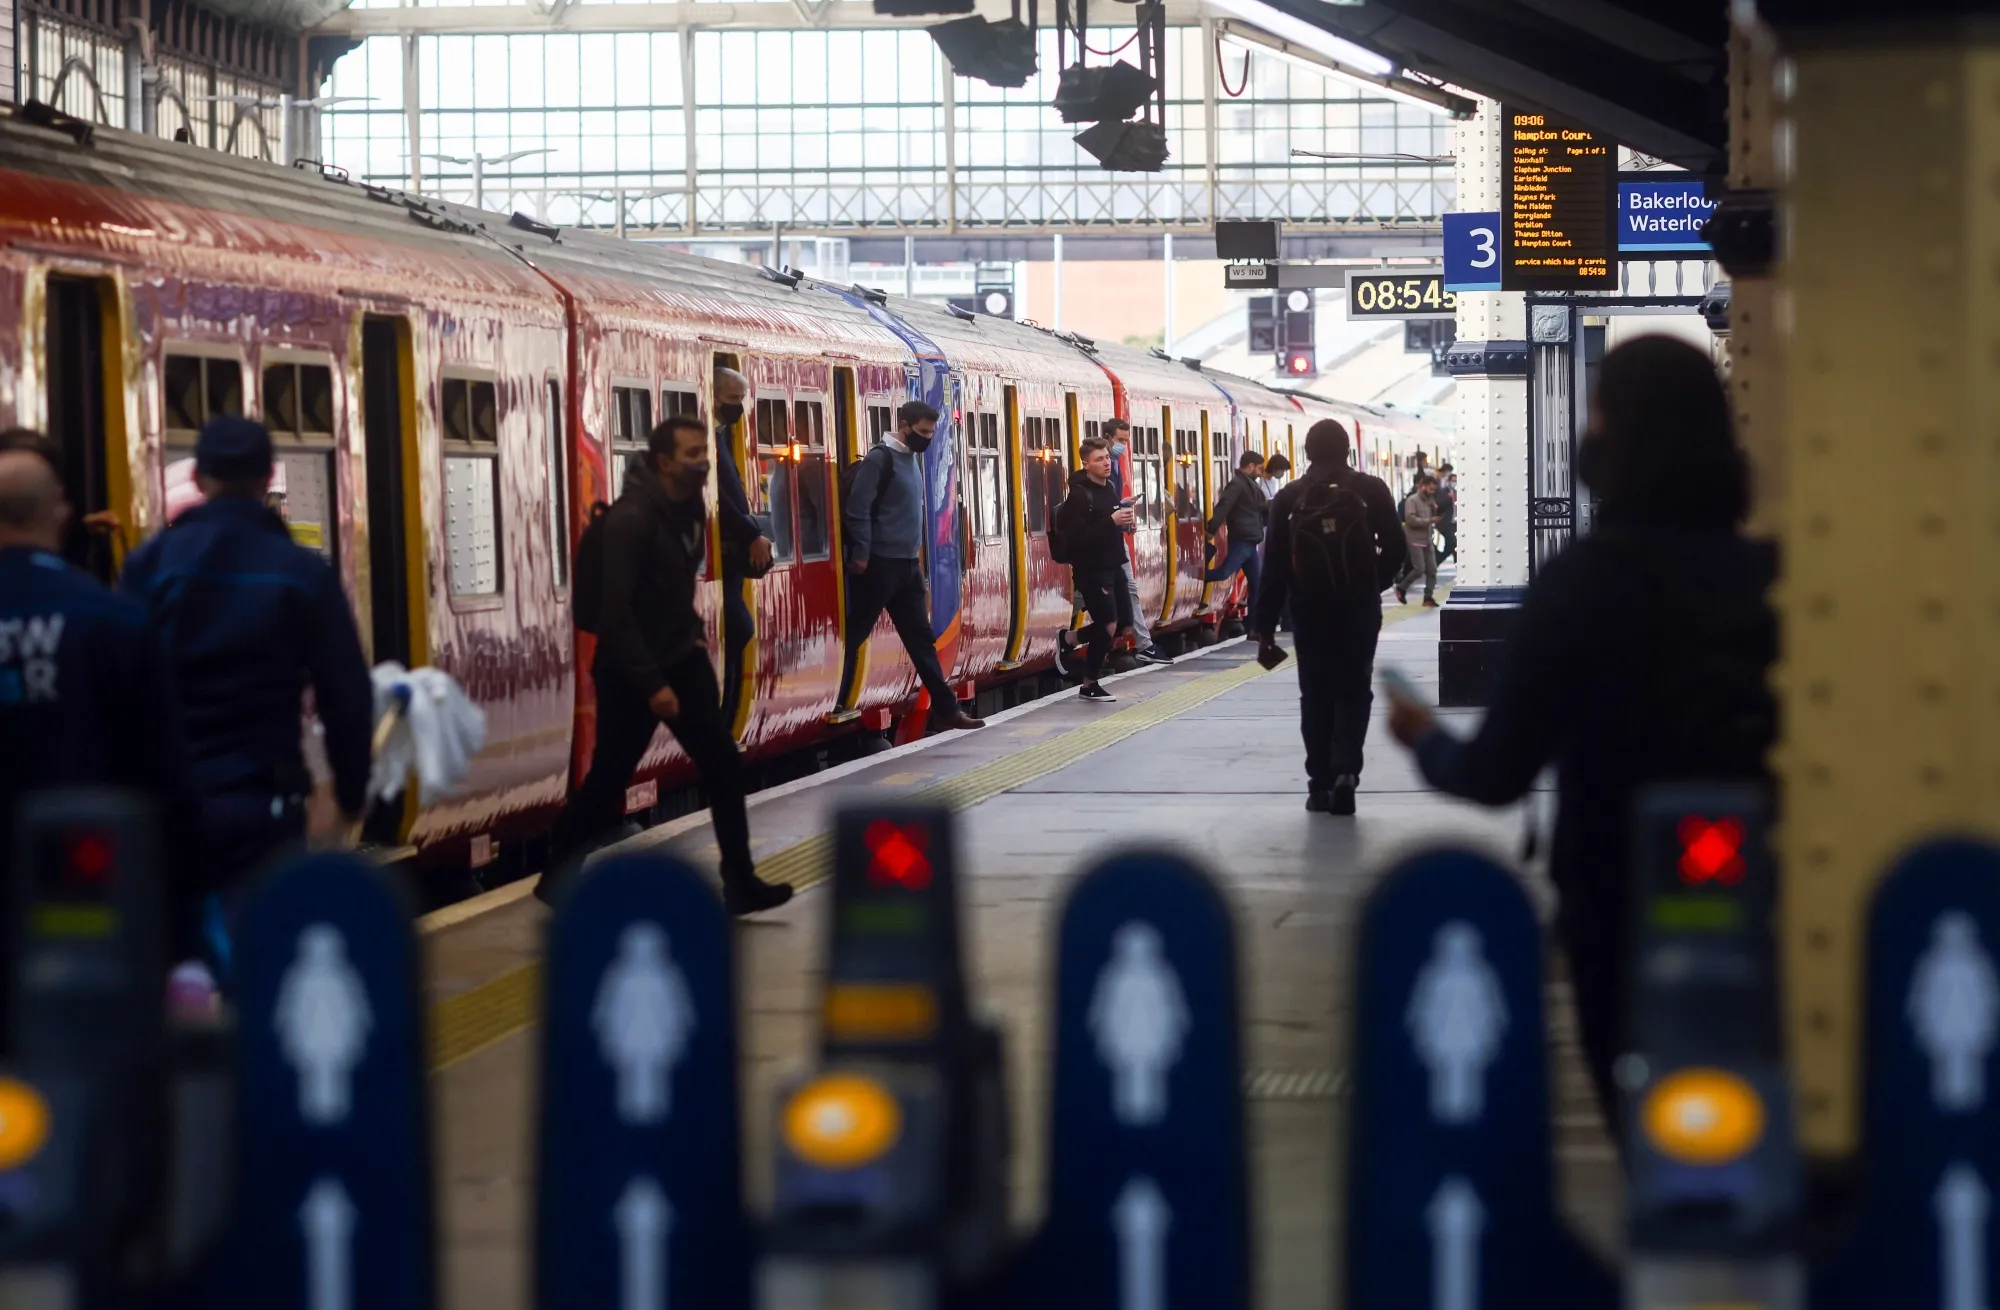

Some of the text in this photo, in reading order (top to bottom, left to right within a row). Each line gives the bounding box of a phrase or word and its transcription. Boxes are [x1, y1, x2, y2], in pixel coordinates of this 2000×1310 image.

[1514, 116, 1545, 126] 09:06
[1514, 130, 1558, 142] Hampton
[1514, 148, 1537, 156] Calling
[1567, 148, 1584, 156] Page
[1514, 166, 1542, 175] Clapham
[1514, 175, 1548, 183] Earlsfield
[1514, 193, 1557, 203] Raynes Park
[1514, 212, 1552, 221] Berrylands
[1514, 221, 1544, 229] Surbiton
[1629, 214, 1711, 231] Waterlo
[1515, 230, 1540, 238] Thames
[1469, 227, 1496, 269] 3
[1522, 240, 1551, 249] Hampton
[1543, 258, 1562, 266] which
[1563, 258, 1577, 266] has
[1577, 258, 1583, 266] 8
[1232, 268, 1264, 276] WS IND
